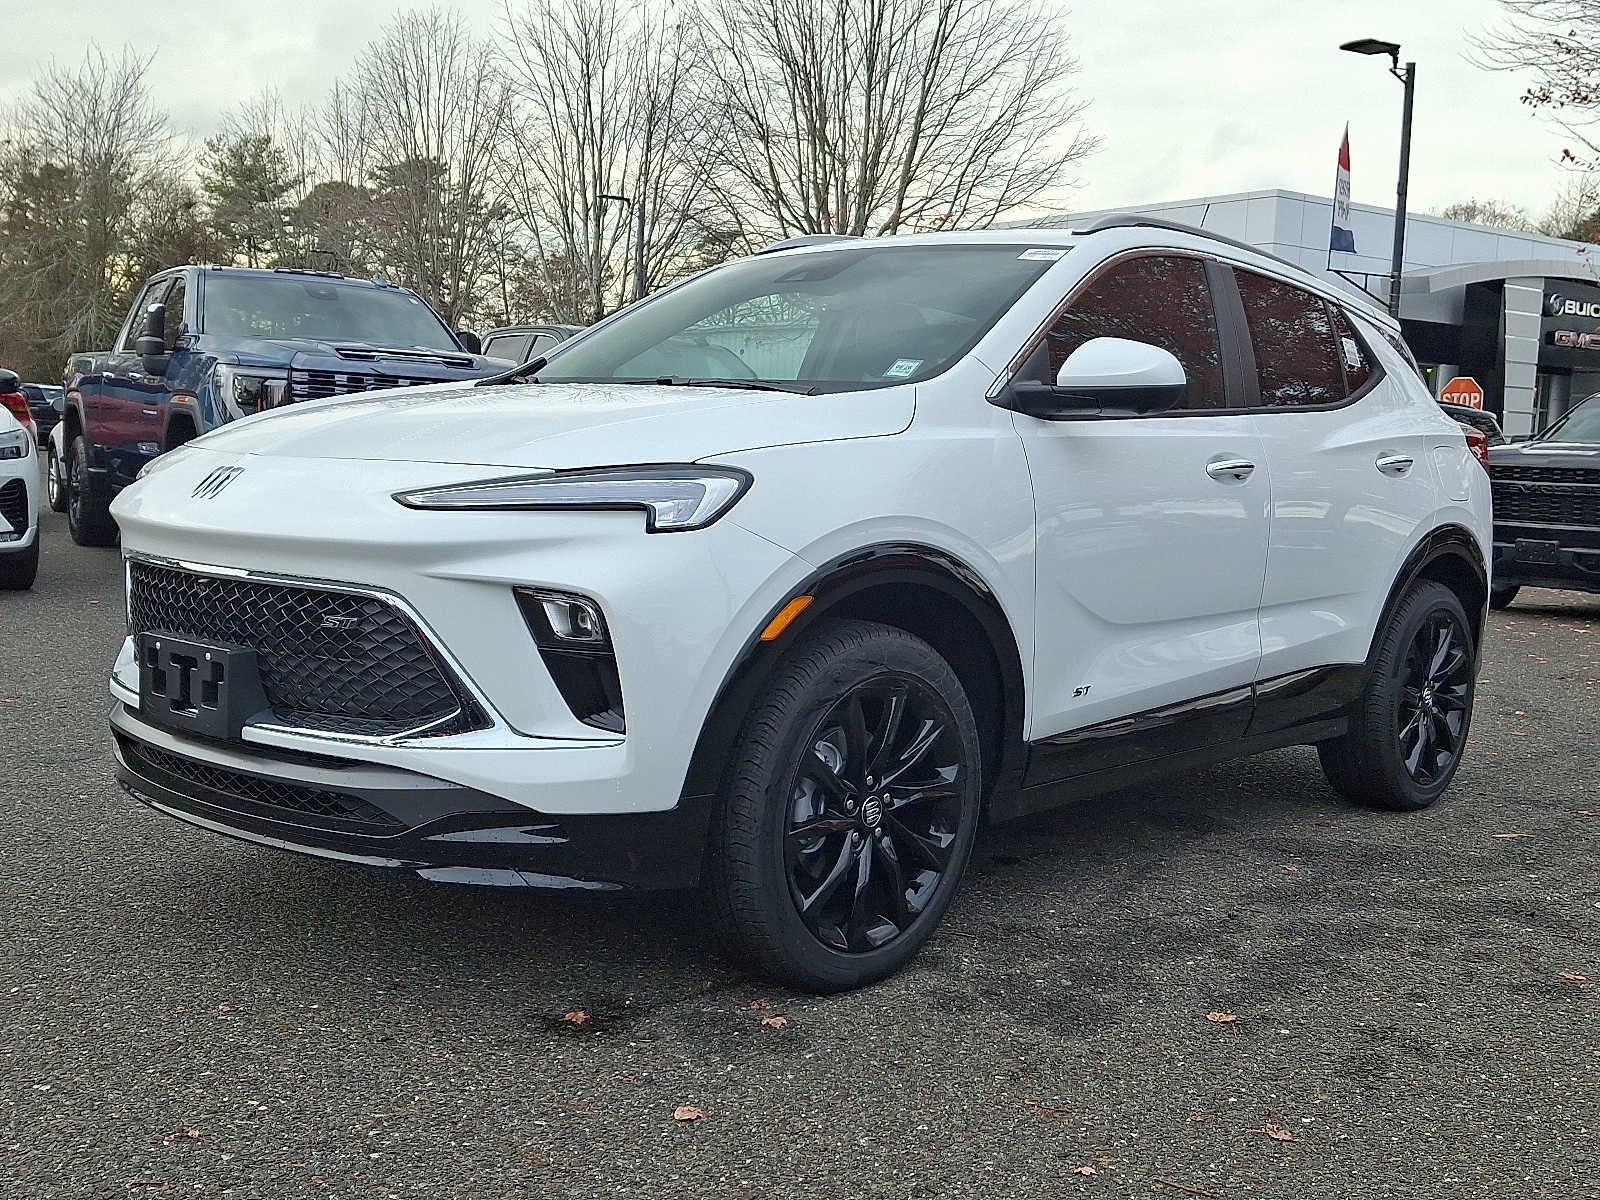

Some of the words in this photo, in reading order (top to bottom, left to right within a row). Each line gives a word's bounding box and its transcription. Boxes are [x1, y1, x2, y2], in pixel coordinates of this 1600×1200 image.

[1442, 392, 1480, 407] STOP
[320, 614, 358, 629] ST
[1073, 685, 1092, 697] ST
